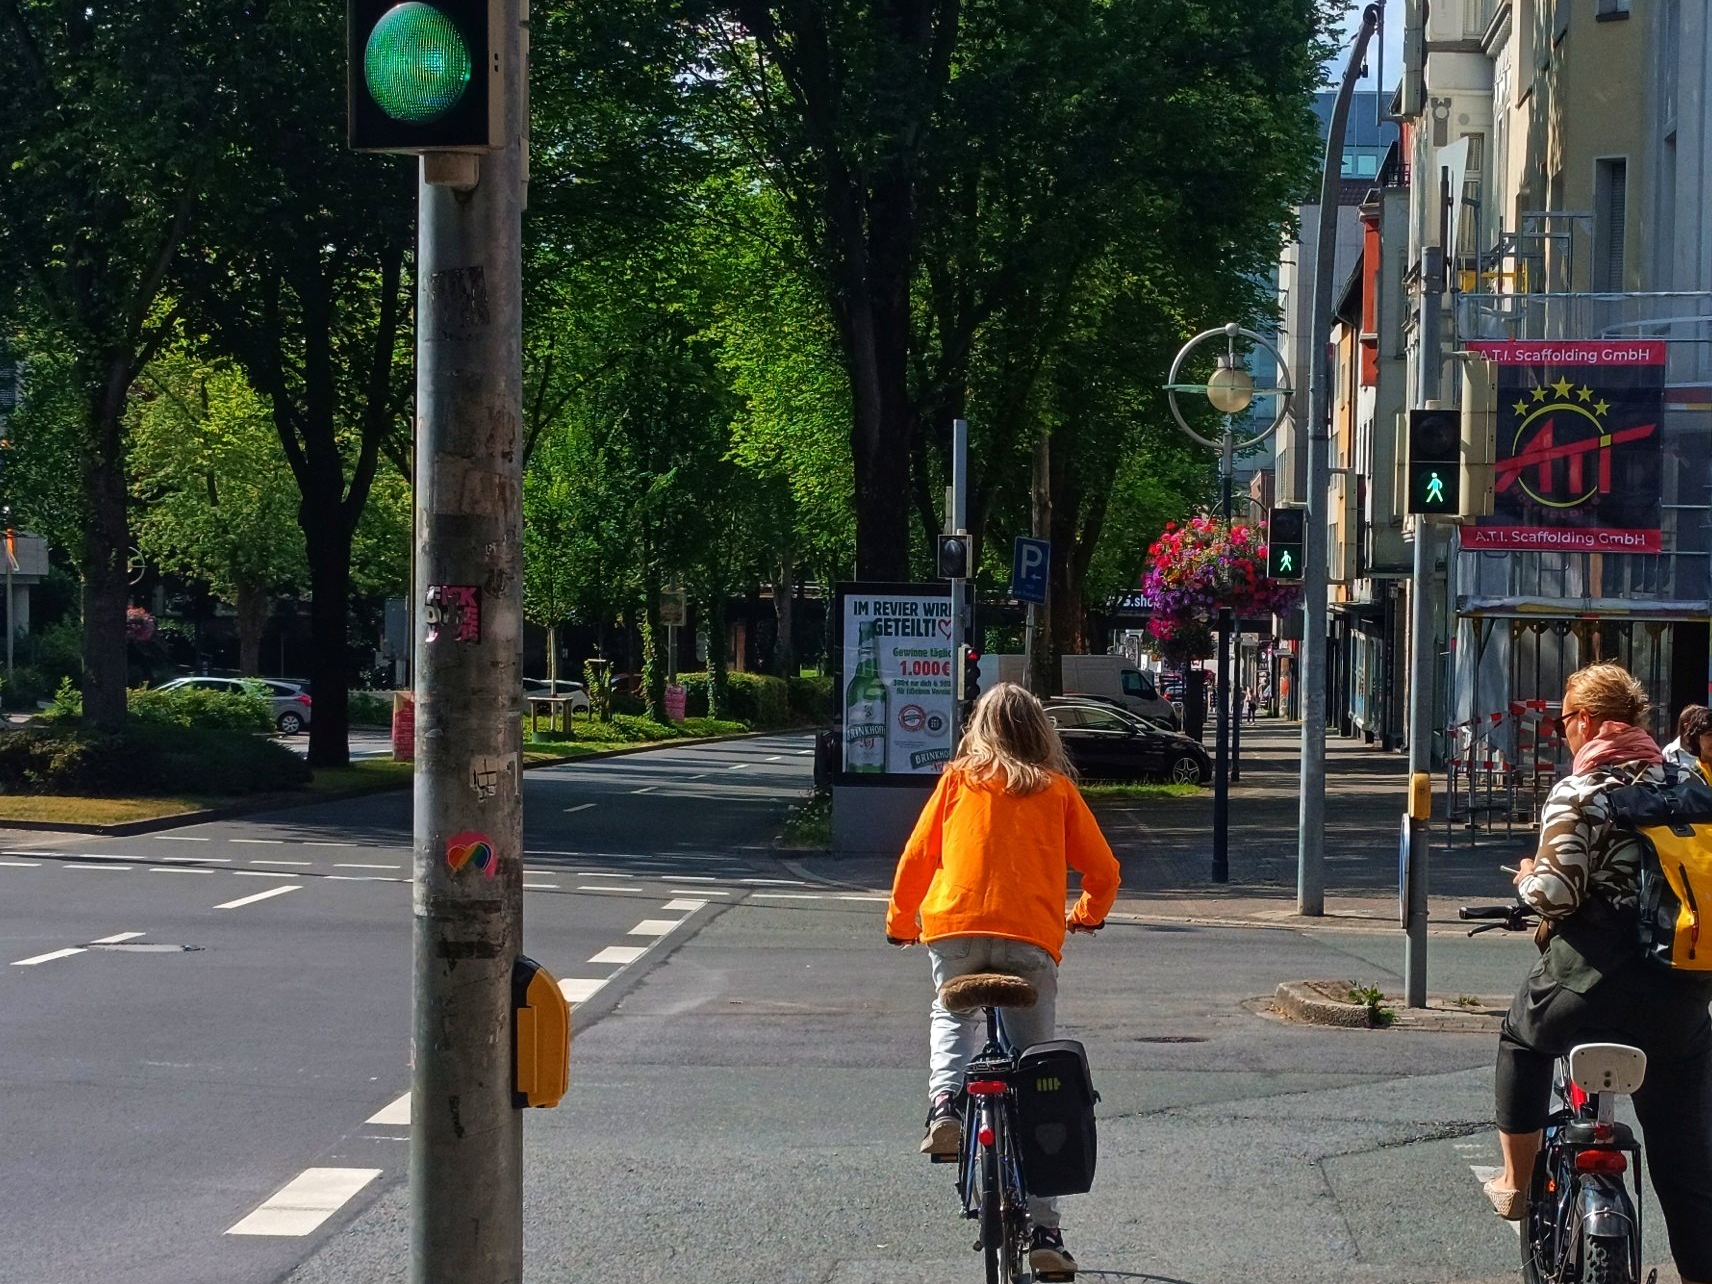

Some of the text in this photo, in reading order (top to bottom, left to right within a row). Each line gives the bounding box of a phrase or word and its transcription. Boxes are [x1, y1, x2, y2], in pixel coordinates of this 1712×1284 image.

[1515, 349, 1598, 364] Scaffolding
[1602, 349, 1650, 361] GmbH
[1475, 531, 1645, 546] A.T.I. Scaffolding GmbH
[1021, 544, 1043, 579] P
[853, 601, 868, 616] IM
[873, 601, 918, 616] REVIER
[874, 618, 936, 637] GETEILT!
[893, 647, 951, 658] Gewinne täglic
